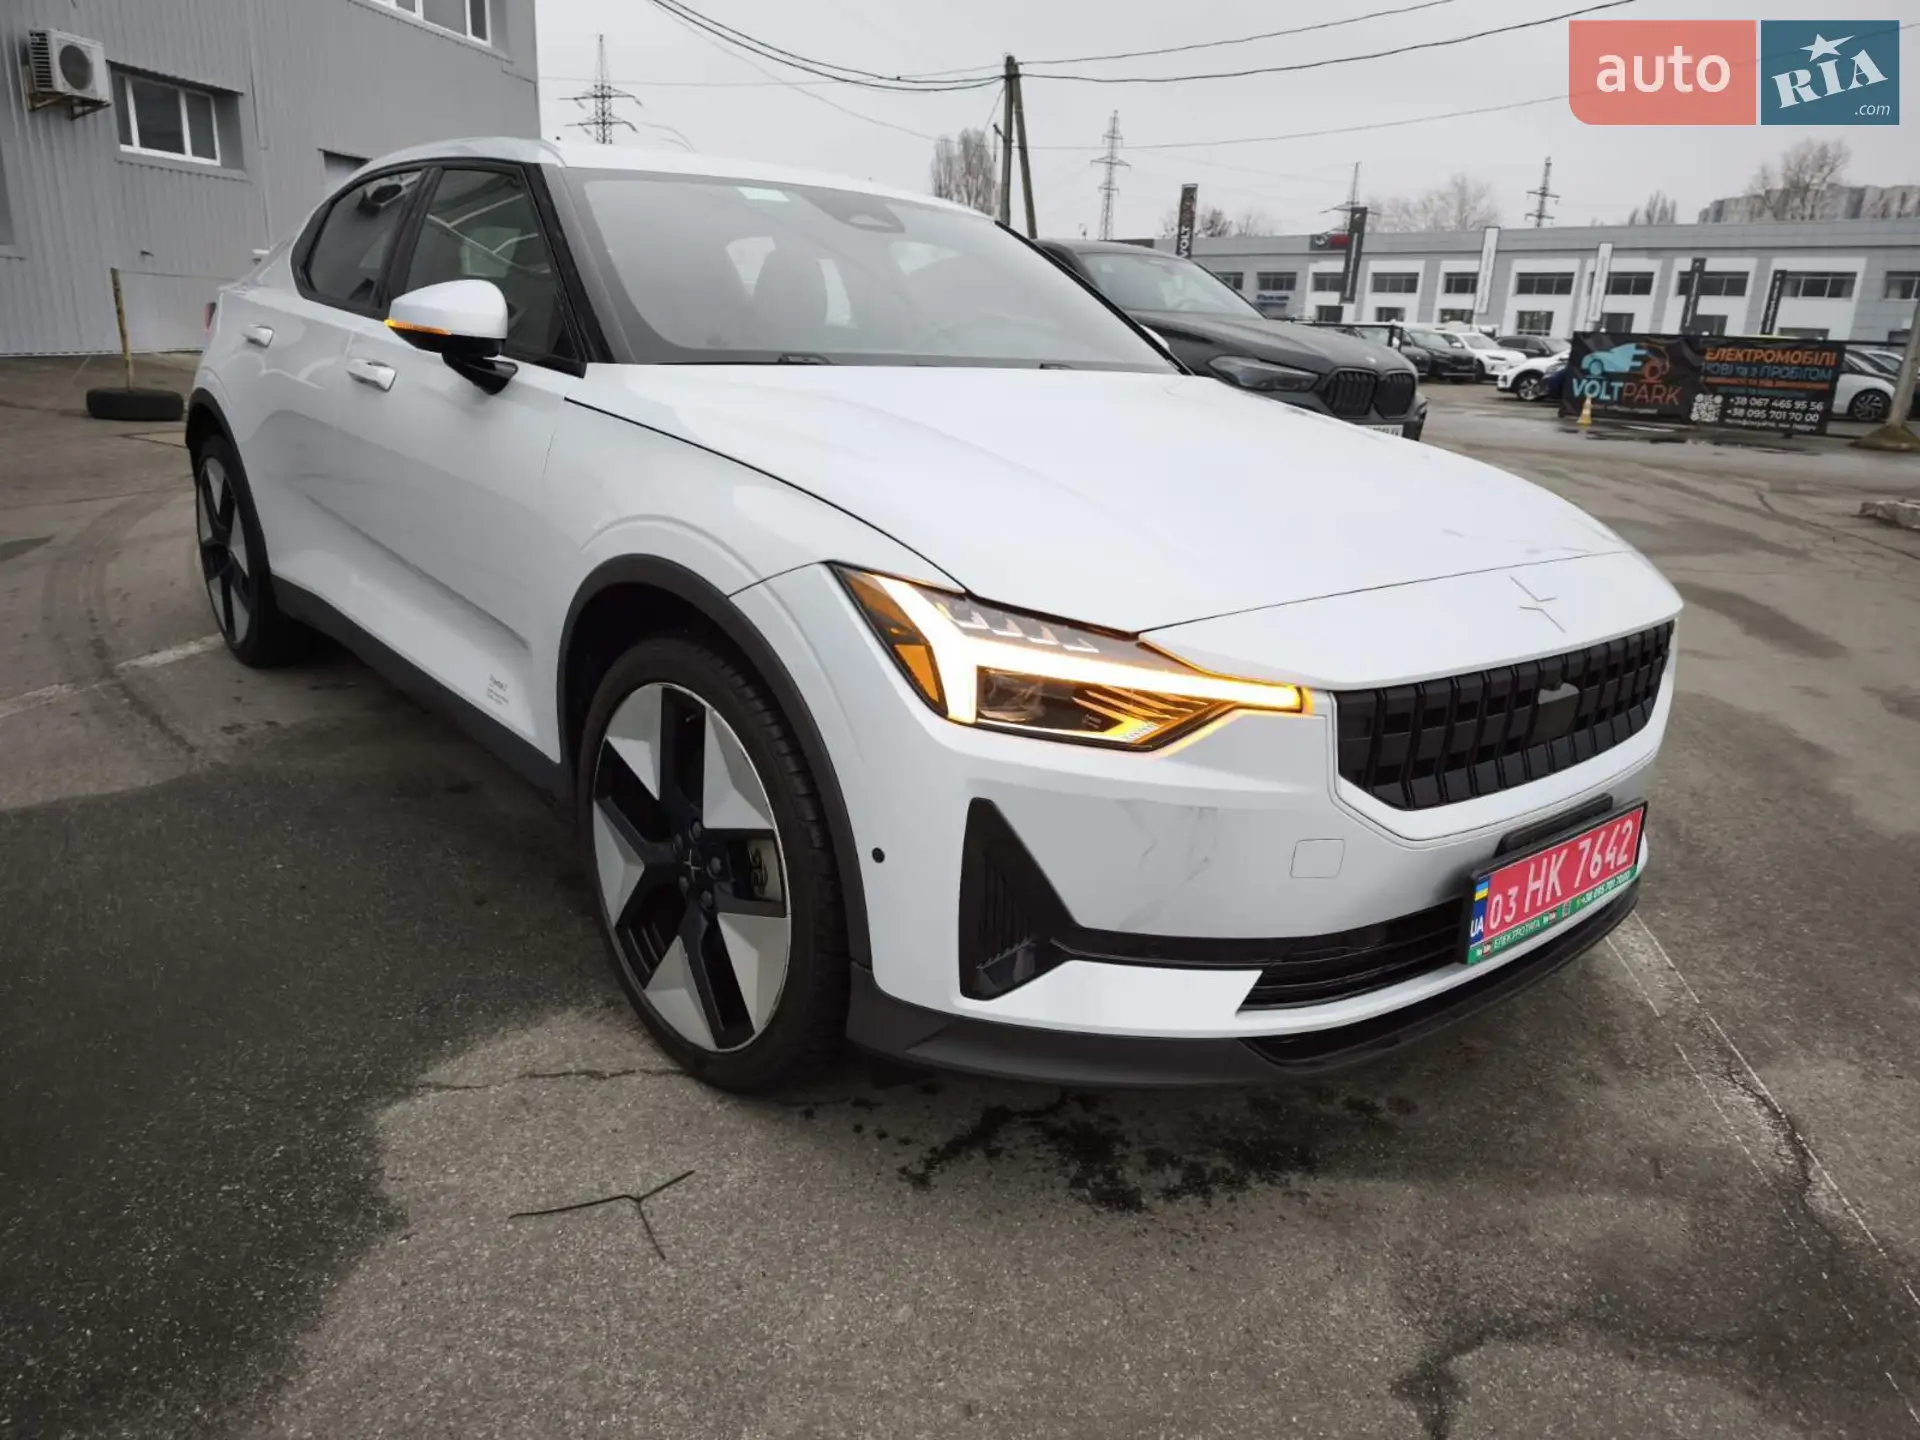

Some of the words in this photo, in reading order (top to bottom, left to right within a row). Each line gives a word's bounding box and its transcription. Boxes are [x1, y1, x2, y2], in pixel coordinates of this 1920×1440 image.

[1705, 347, 1837, 366] ЕЛЕКТРОМОБІЛІ
[1701, 361, 1733, 376] НОВІ
[1759, 364, 1833, 380] ПРОБІГОМ
[1748, 397, 1770, 407] 067
[1808, 401, 1824, 412] 56
[1746, 409, 1767, 419] 095
[1768, 410, 1787, 420] 701
[1787, 412, 1803, 422] 70
[1489, 886, 1519, 930] 03
[1524, 848, 1568, 913] HK
[1574, 819, 1633, 889] 7642
[1470, 915, 1484, 938] UA
